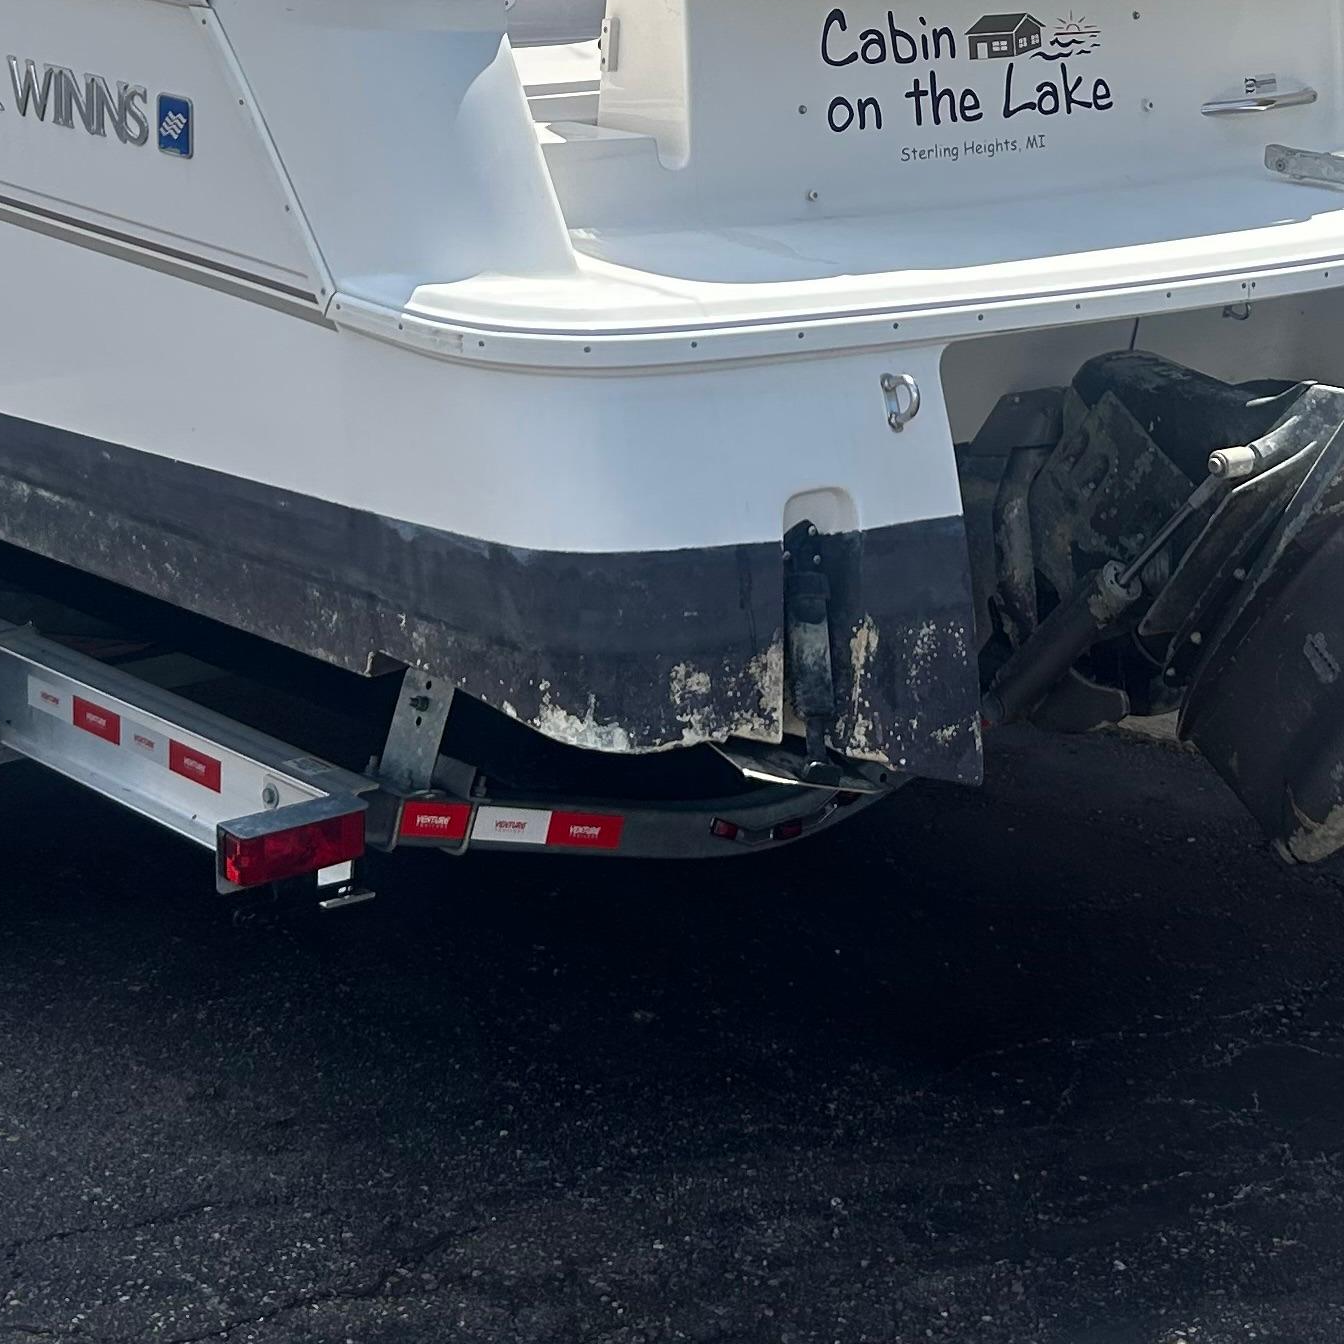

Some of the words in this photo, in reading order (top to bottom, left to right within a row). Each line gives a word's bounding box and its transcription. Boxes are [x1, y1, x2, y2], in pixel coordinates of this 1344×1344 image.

[821, 8, 956, 66] Cabin
[6, 54, 150, 146] WINNS
[827, 96, 882, 132] on
[905, 70, 983, 125] the
[1003, 62, 1114, 118] Lake
[900, 144, 959, 162] Sterling
[963, 138, 1022, 157] Heights,
[1026, 134, 1047, 149] MI
